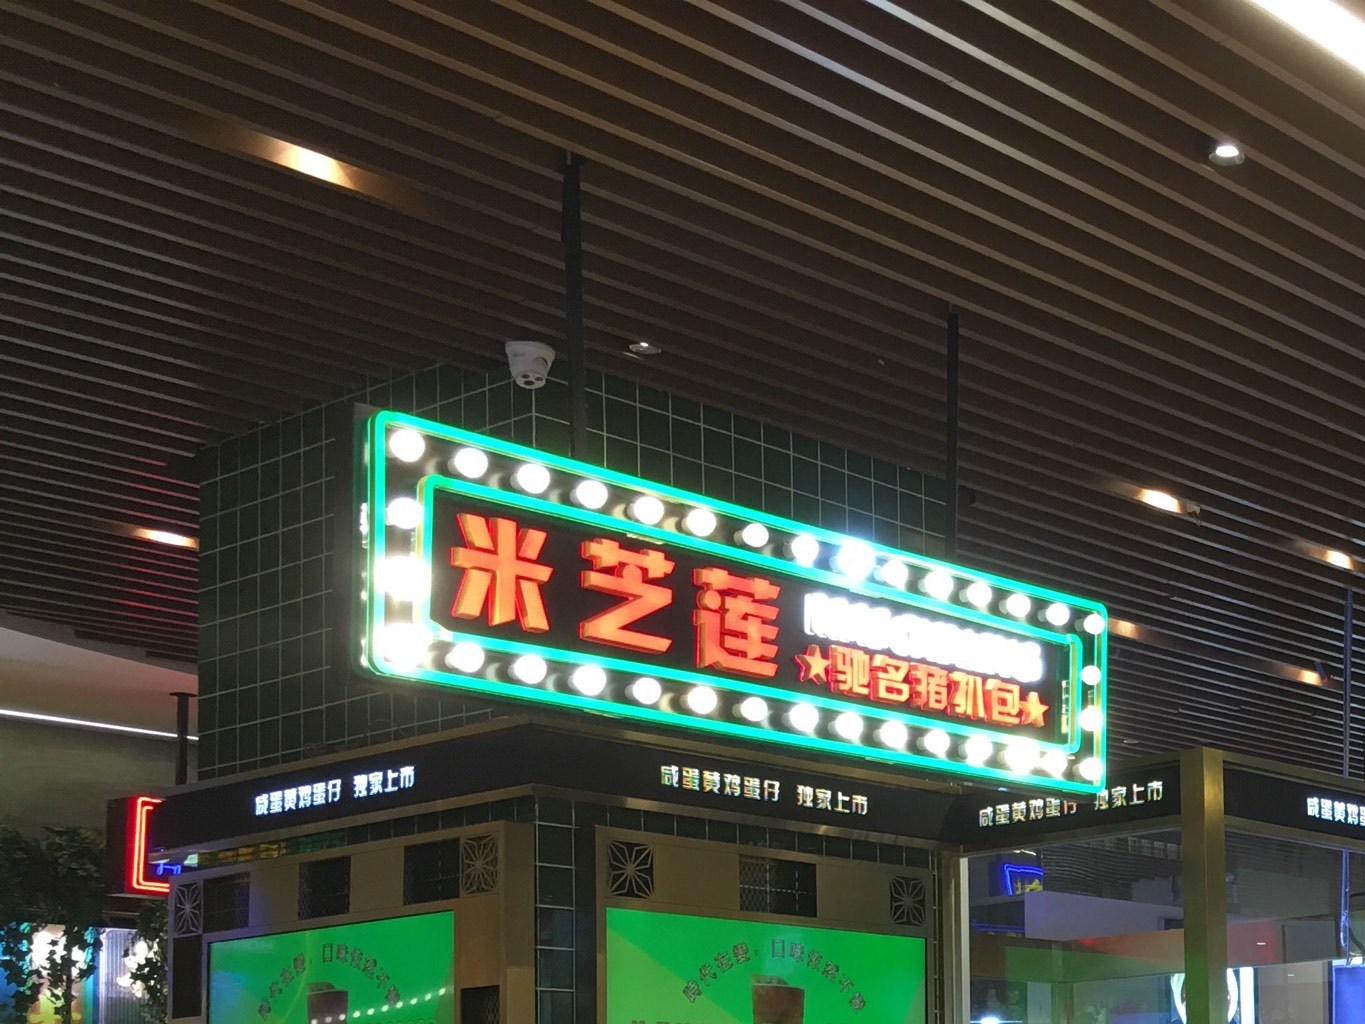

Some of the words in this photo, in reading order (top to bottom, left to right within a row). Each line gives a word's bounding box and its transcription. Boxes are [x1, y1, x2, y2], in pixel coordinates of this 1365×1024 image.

[449, 511, 781, 678] 米芝莲
[828, 644, 1021, 726] 驰名猪扒包
[254, 778, 342, 816] 咸蛋黄鸡蛋仔
[353, 765, 416, 799] 独家上市
[660, 764, 781, 803] 咸蛋黄鸡蛋仔
[796, 783, 868, 816] 独家上市
